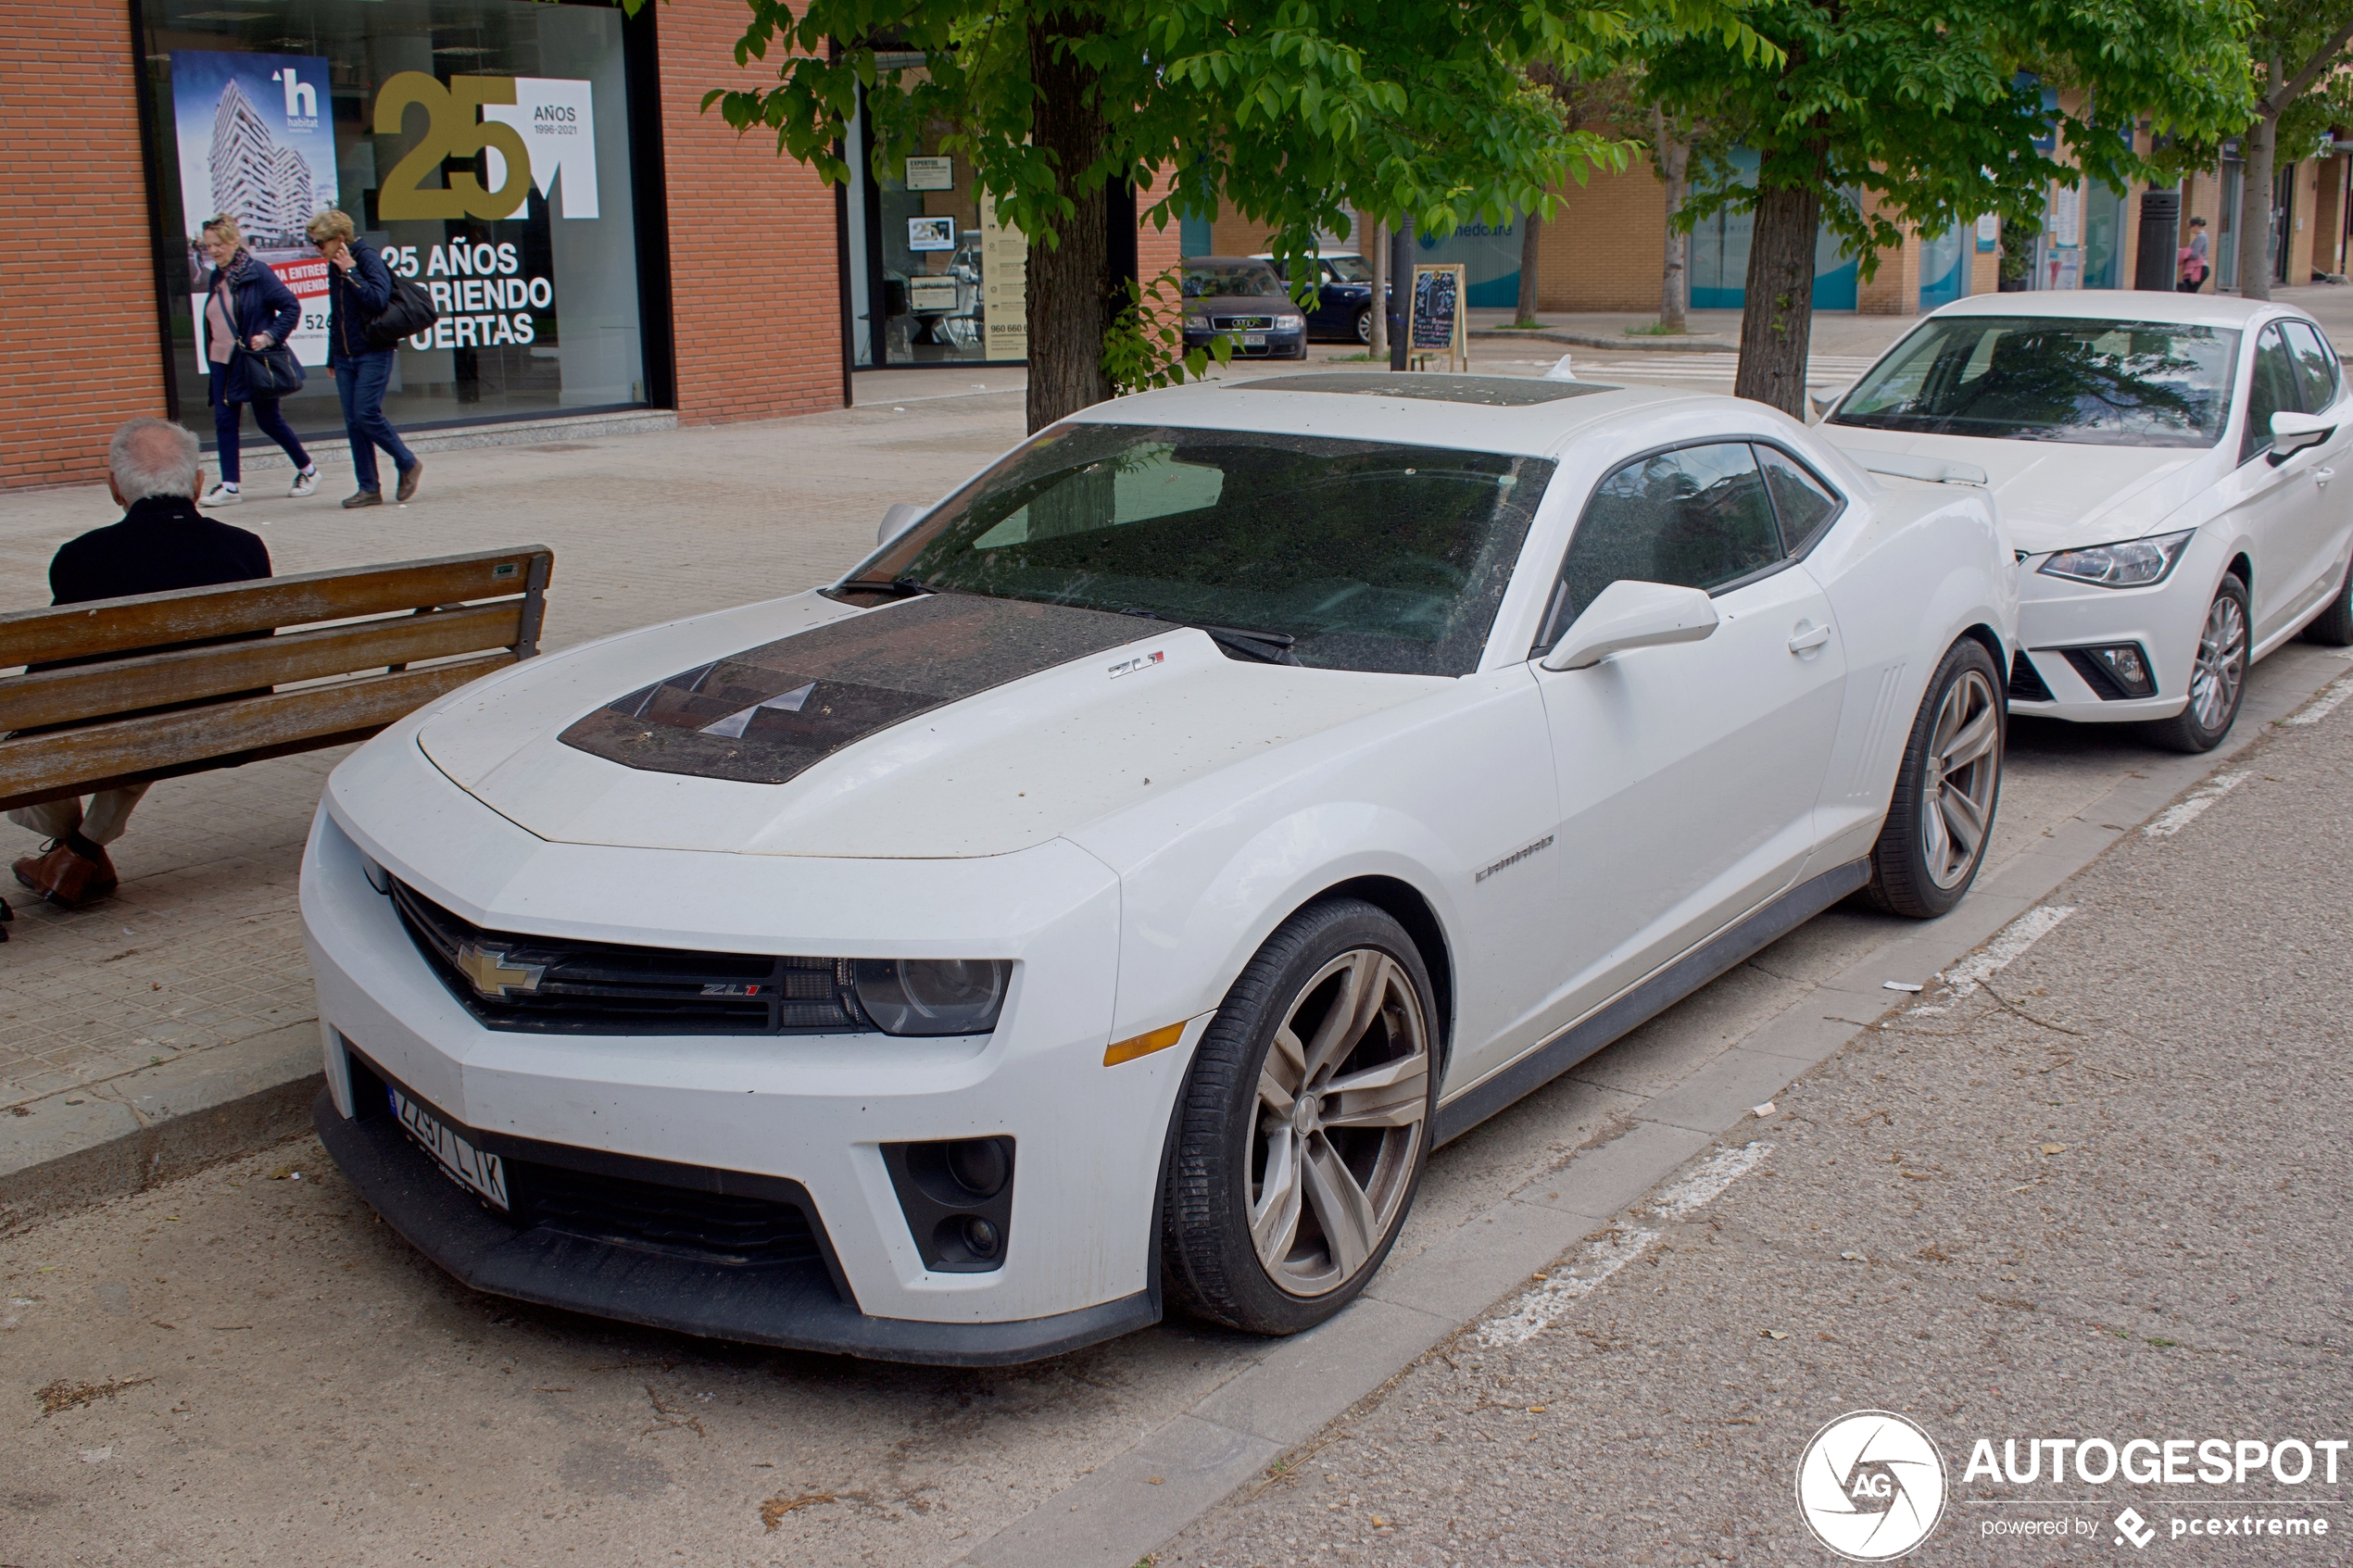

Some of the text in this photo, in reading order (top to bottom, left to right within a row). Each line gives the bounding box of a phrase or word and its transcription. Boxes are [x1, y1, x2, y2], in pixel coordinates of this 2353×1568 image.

[534, 105, 576, 122] AÑOS
[287, 118, 319, 129] habitat
[535, 124, 577, 135] 1996-2021
[373, 70, 531, 221] 25
[381, 236, 519, 278] 25 AÑOS
[290, 264, 329, 280] ENTREG
[990, 324, 1006, 333] 960
[1007, 324, 1022, 333] 660
[1108, 650, 1164, 679] ZL1
[1475, 834, 1554, 884] CAMARO
[700, 984, 760, 997] ZL1
